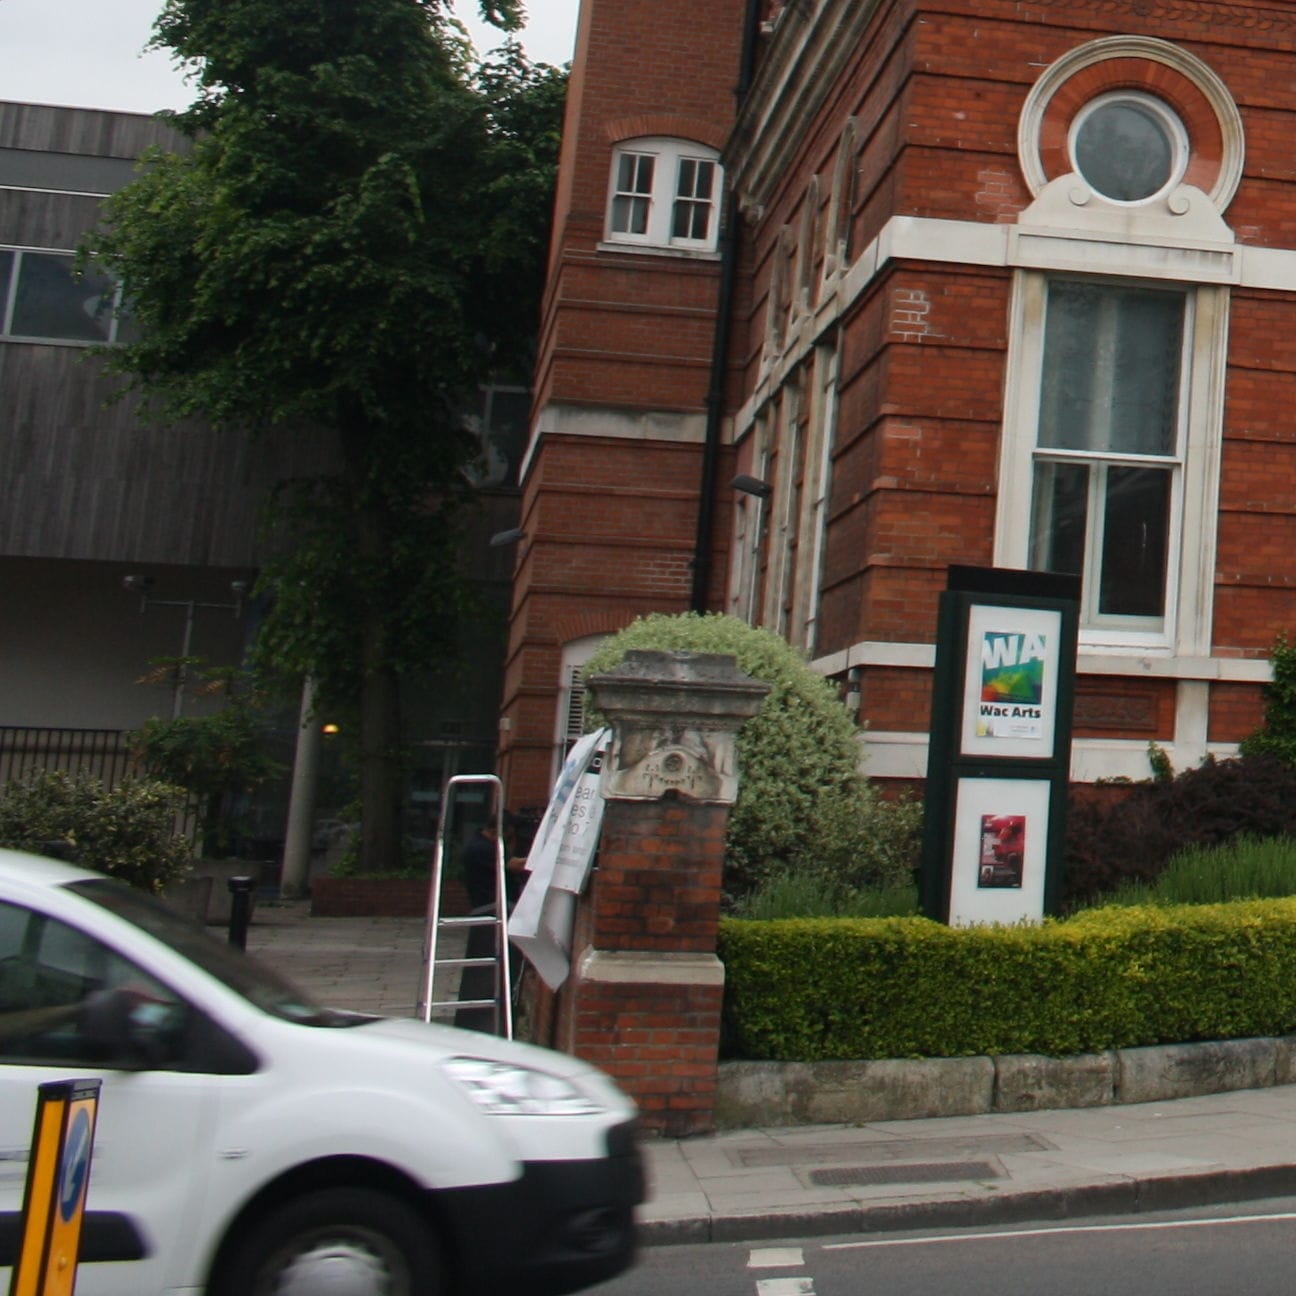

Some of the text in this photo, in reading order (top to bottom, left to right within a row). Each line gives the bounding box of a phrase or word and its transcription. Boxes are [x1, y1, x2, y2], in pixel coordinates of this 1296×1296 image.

[981, 632, 1046, 669] WA
[980, 705, 1042, 718] Wac Arts
